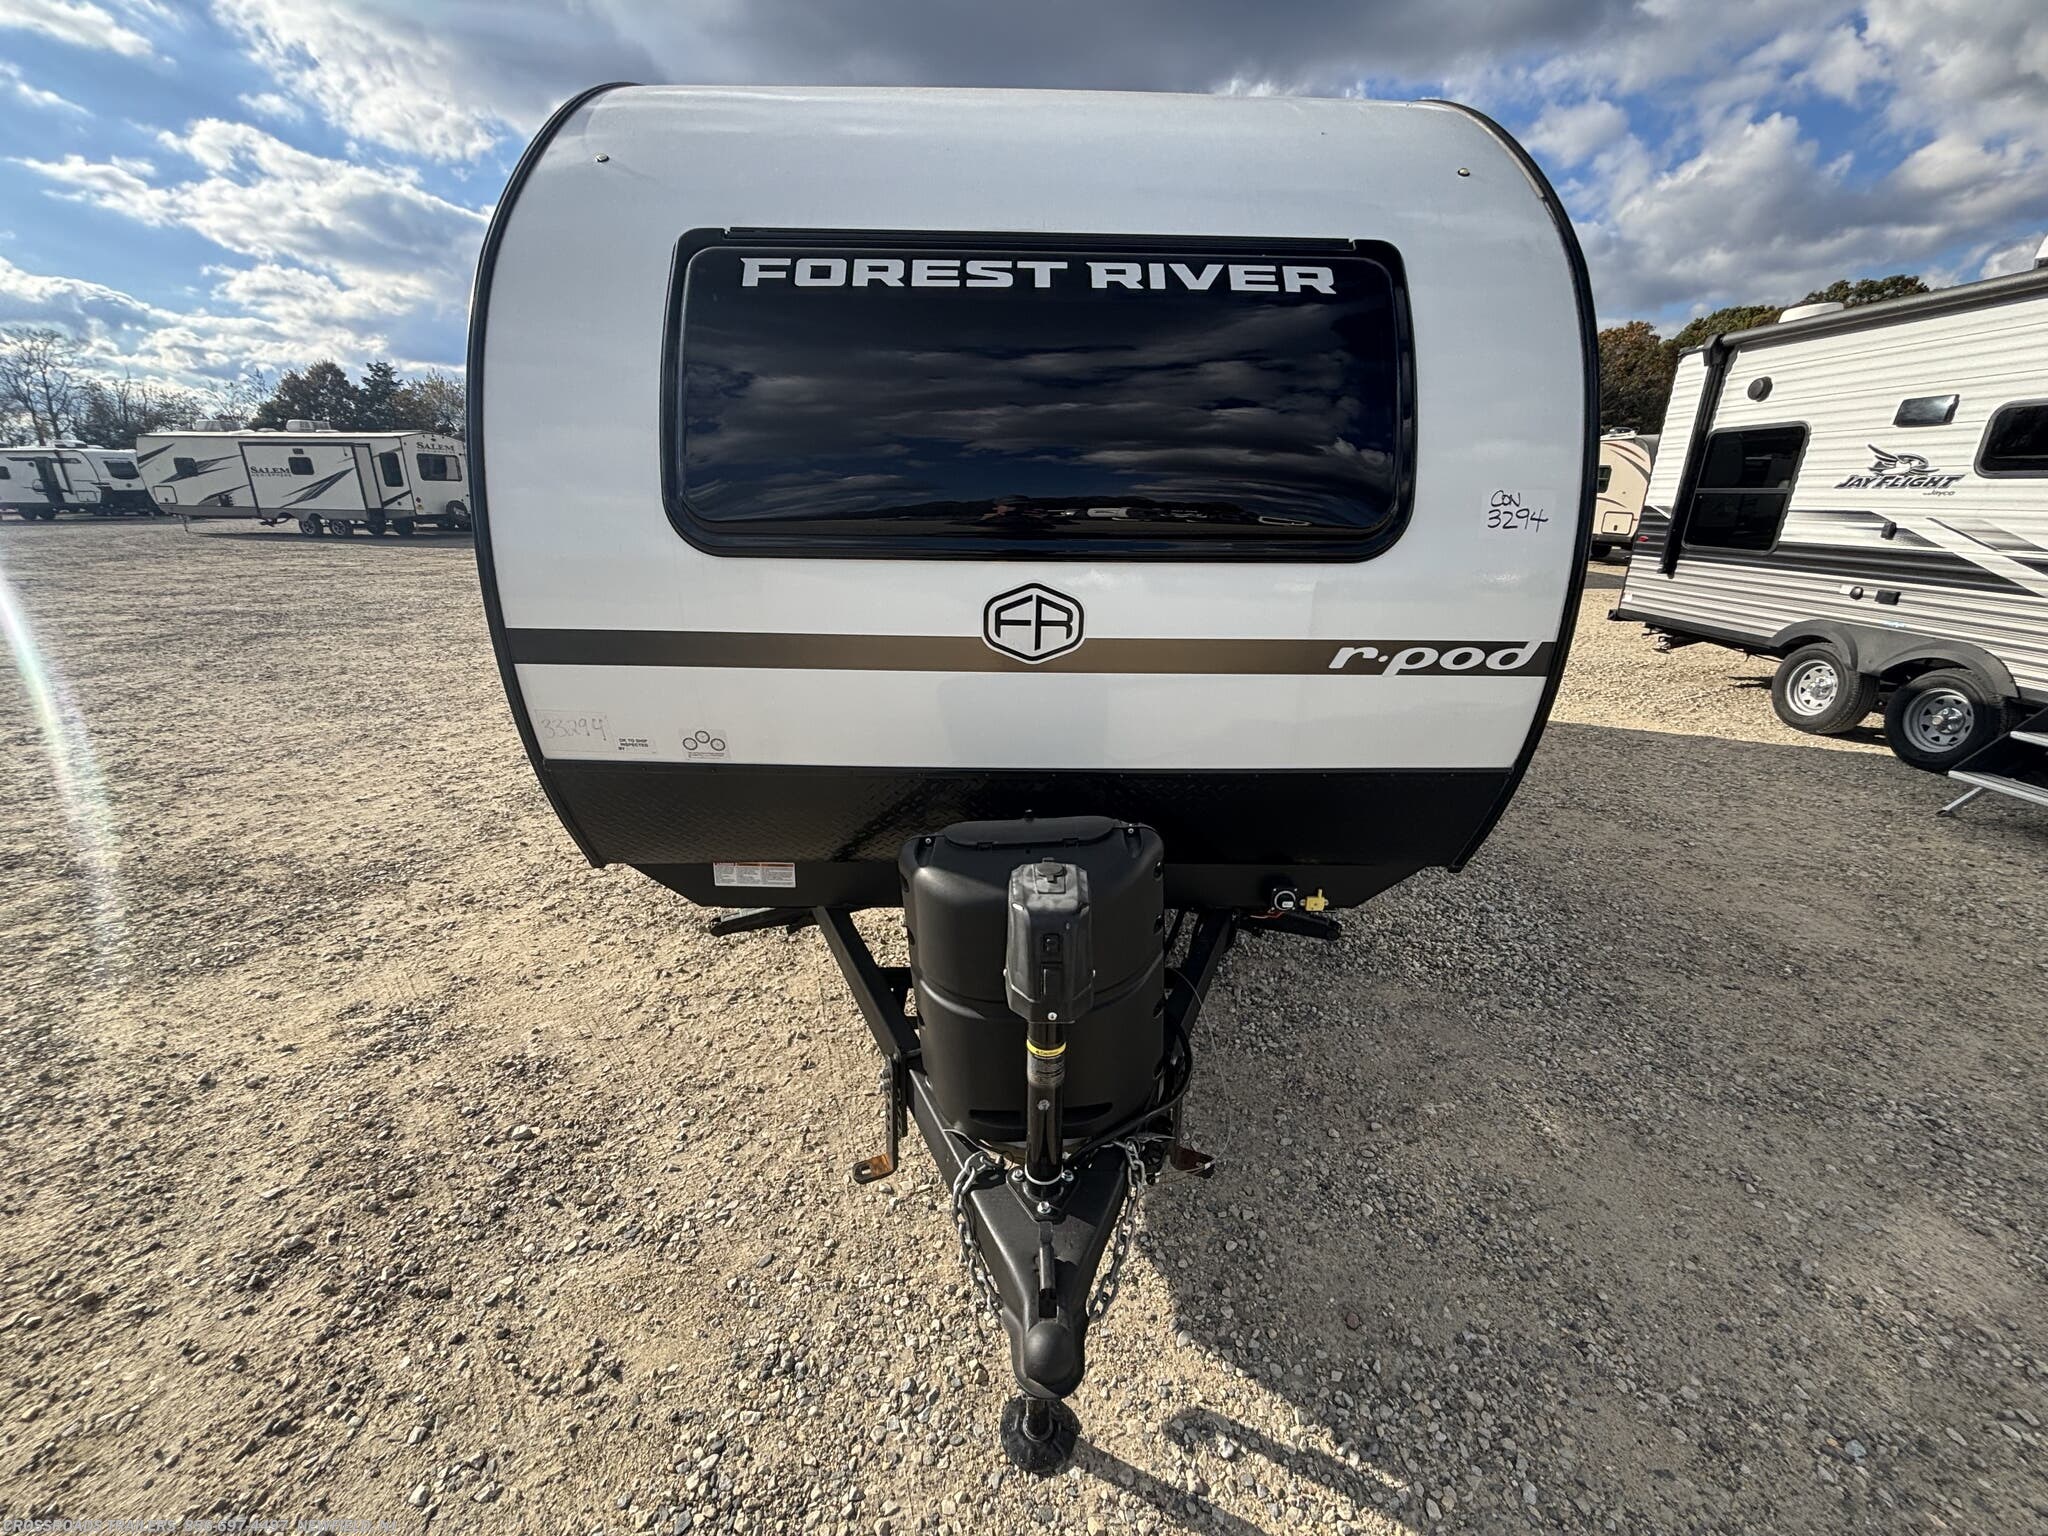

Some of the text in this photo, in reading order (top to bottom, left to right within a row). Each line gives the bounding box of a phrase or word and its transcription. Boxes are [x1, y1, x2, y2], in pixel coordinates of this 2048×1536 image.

[740, 257, 1337, 294] FOREST RIVER
[416, 442, 455, 451] SALEM
[250, 466, 291, 474] SALEM
[1834, 475, 1966, 488] JAY FLIGHT
[1488, 508, 1549, 533] 3294
[541, 718, 607, 741] 33294
